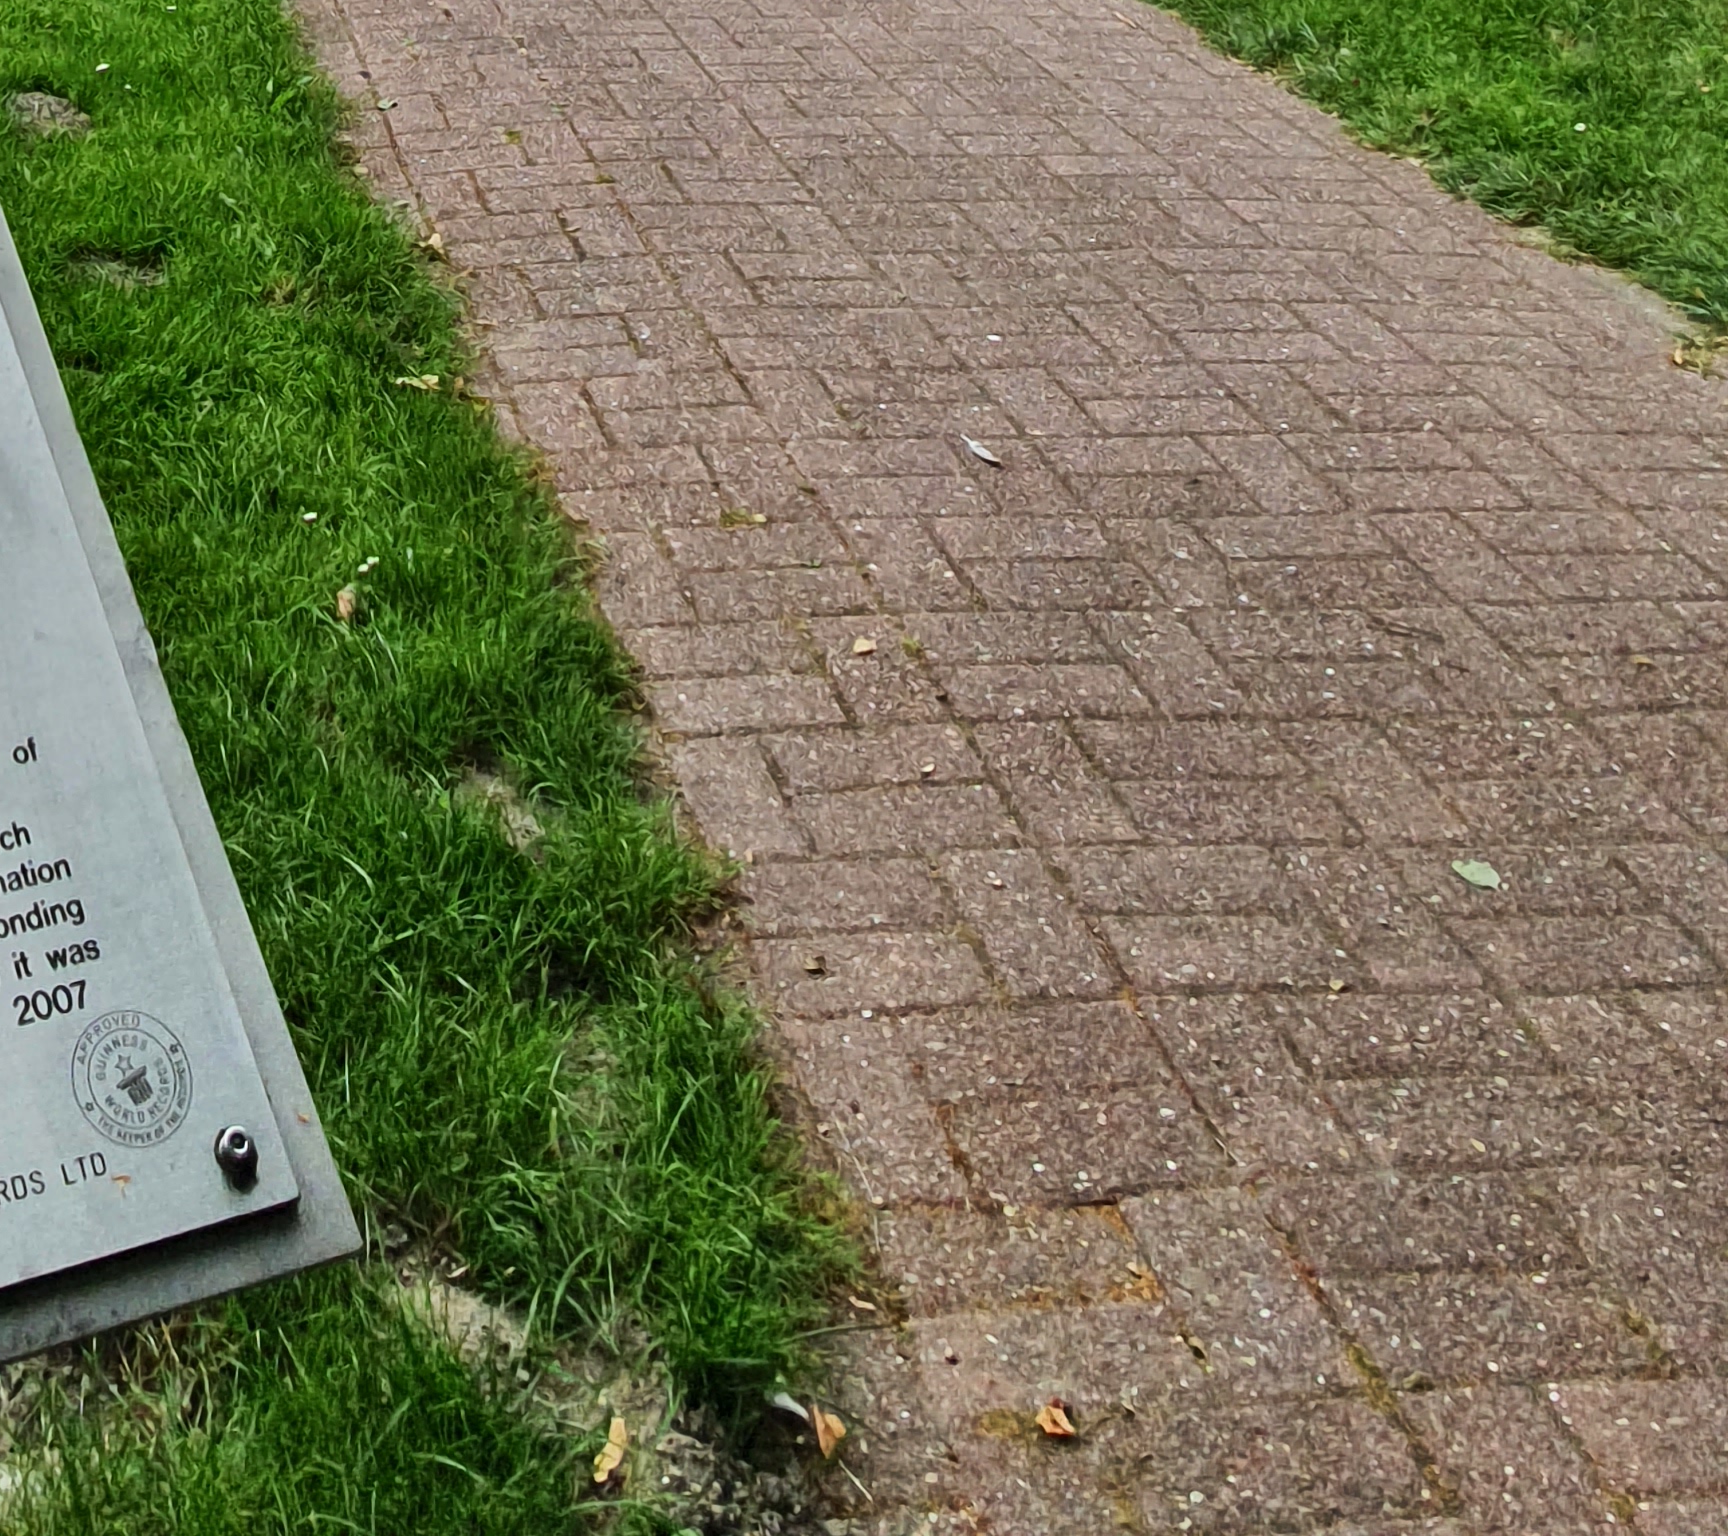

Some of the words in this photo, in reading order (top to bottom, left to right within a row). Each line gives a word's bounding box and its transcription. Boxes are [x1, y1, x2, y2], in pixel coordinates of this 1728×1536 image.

[12, 736, 38, 765] of
[11, 951, 33, 981] it
[44, 939, 101, 972] was
[12, 978, 87, 1027] 2007
[76, 1014, 141, 1066] APPROVED
[95, 1034, 148, 1081] GUINNESS
[60, 1151, 107, 1186] LTD
